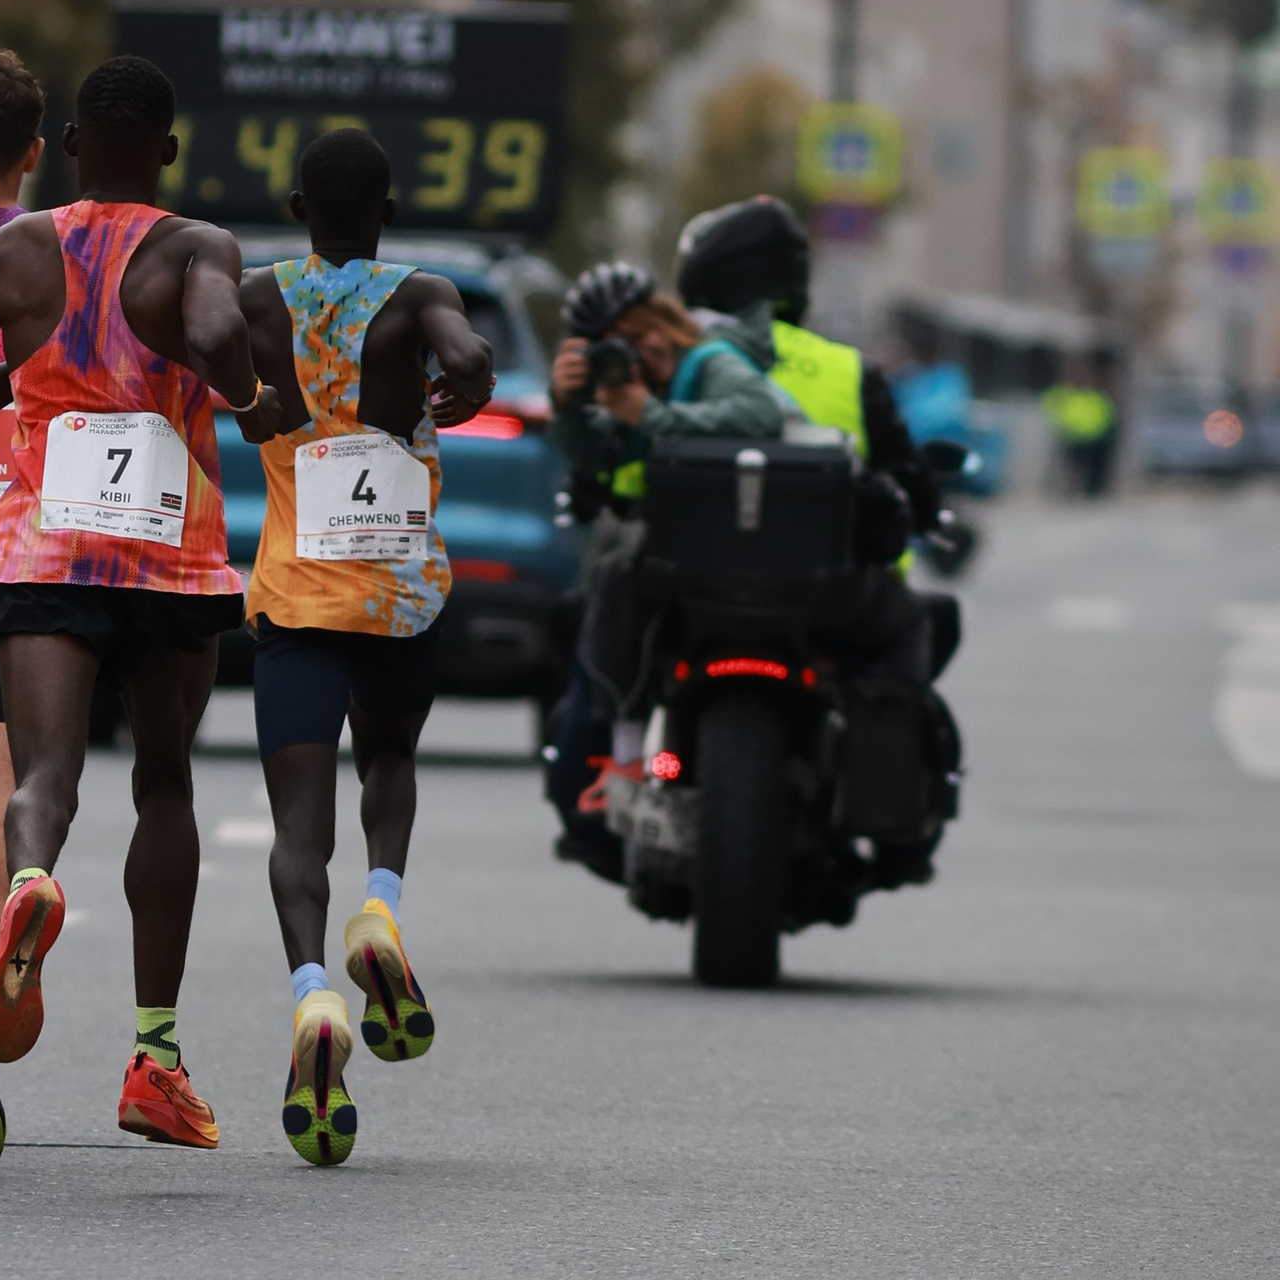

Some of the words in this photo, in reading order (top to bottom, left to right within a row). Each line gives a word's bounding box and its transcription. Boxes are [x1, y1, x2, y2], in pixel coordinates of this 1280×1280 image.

[222, 7, 455, 61] HUAWEI
[89, 422, 139, 430] МОСКОВСКИЙ
[331, 444, 379, 452] МОСКОВСКИЙ
[107, 448, 132, 484] 7
[351, 468, 377, 505] 4
[100, 490, 131, 503] KIBII
[328, 513, 401, 527] CHEMWENO
